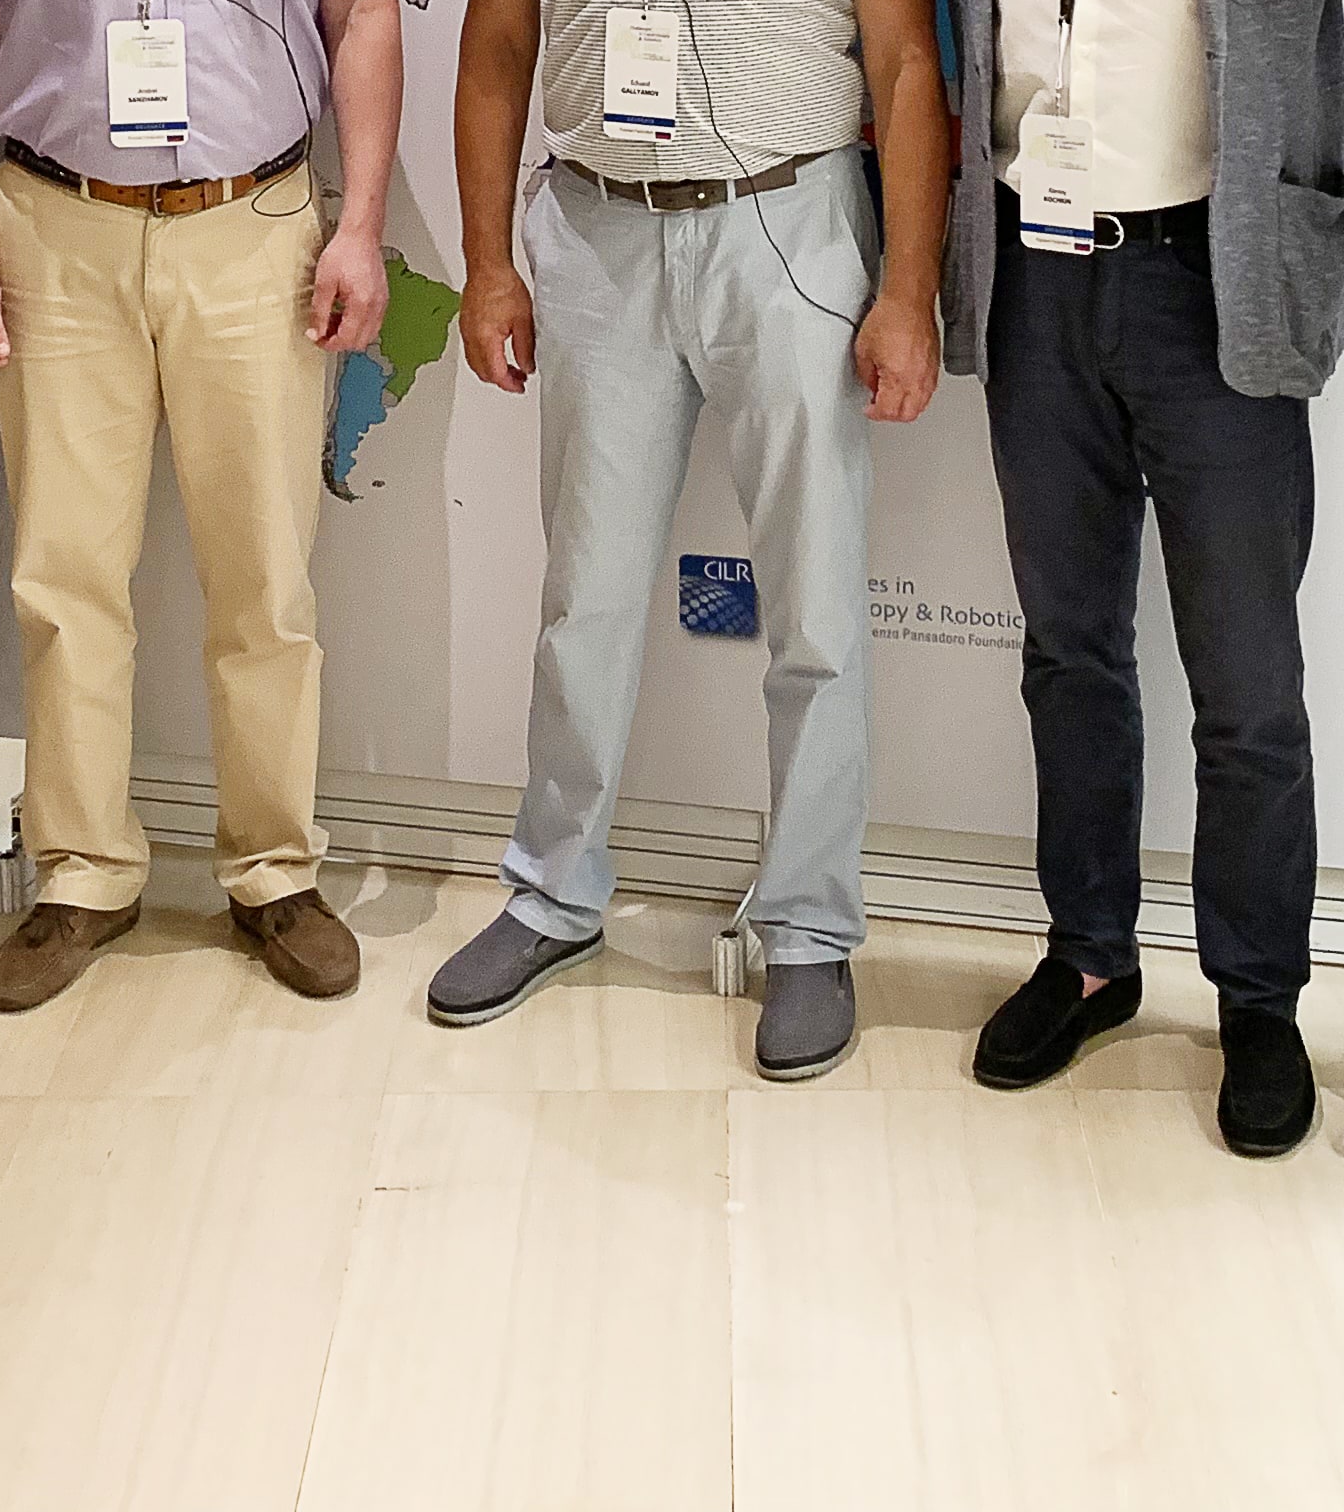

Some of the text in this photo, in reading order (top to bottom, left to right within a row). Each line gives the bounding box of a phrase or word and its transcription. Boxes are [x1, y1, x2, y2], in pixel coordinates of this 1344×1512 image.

[704, 561, 752, 583] CILR
[896, 576, 914, 595] in
[870, 603, 1023, 629] opy & Robotic
[902, 628, 966, 646] Pansadoro
